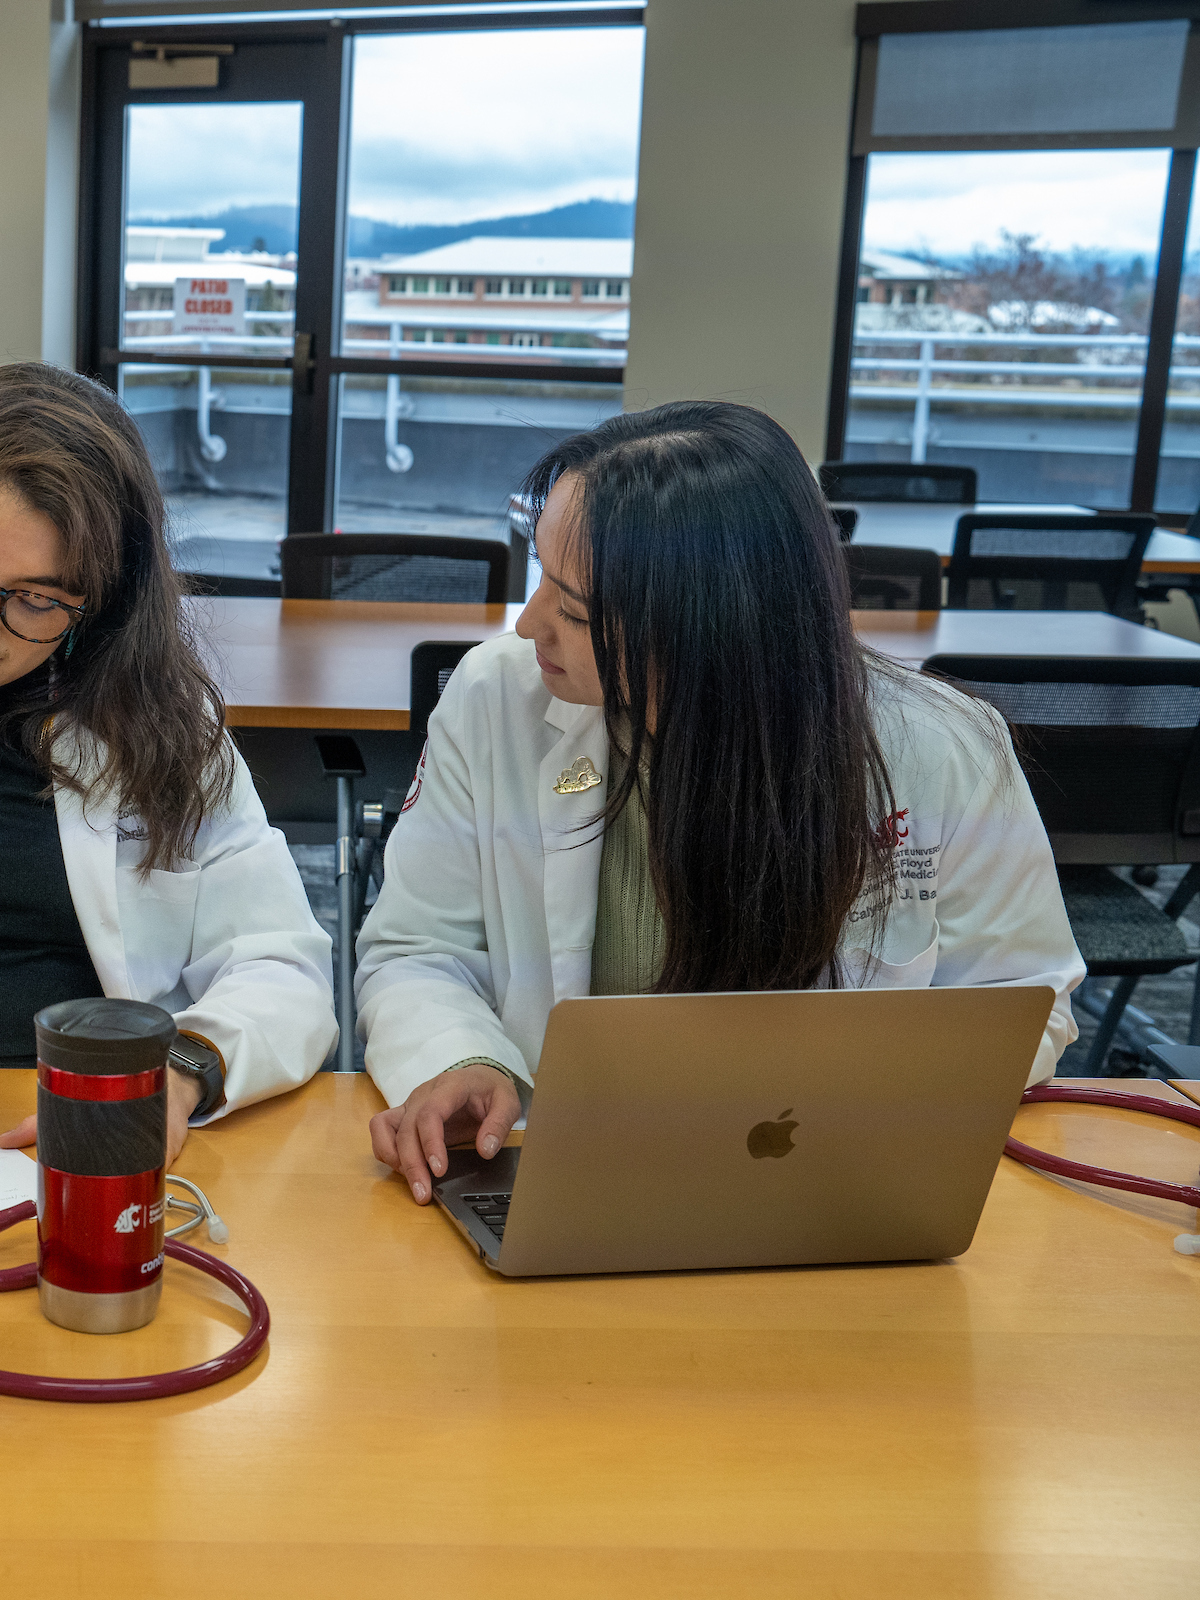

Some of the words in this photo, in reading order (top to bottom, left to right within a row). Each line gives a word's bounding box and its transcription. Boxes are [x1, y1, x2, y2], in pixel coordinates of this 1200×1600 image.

[191, 279, 228, 294] PATIO
[185, 299, 232, 314] CLOSED
[910, 845, 940, 856] UNIVERS
[900, 857, 932, 869] Floyd
[900, 868, 938, 880] Medici
[919, 889, 937, 900] Ba
